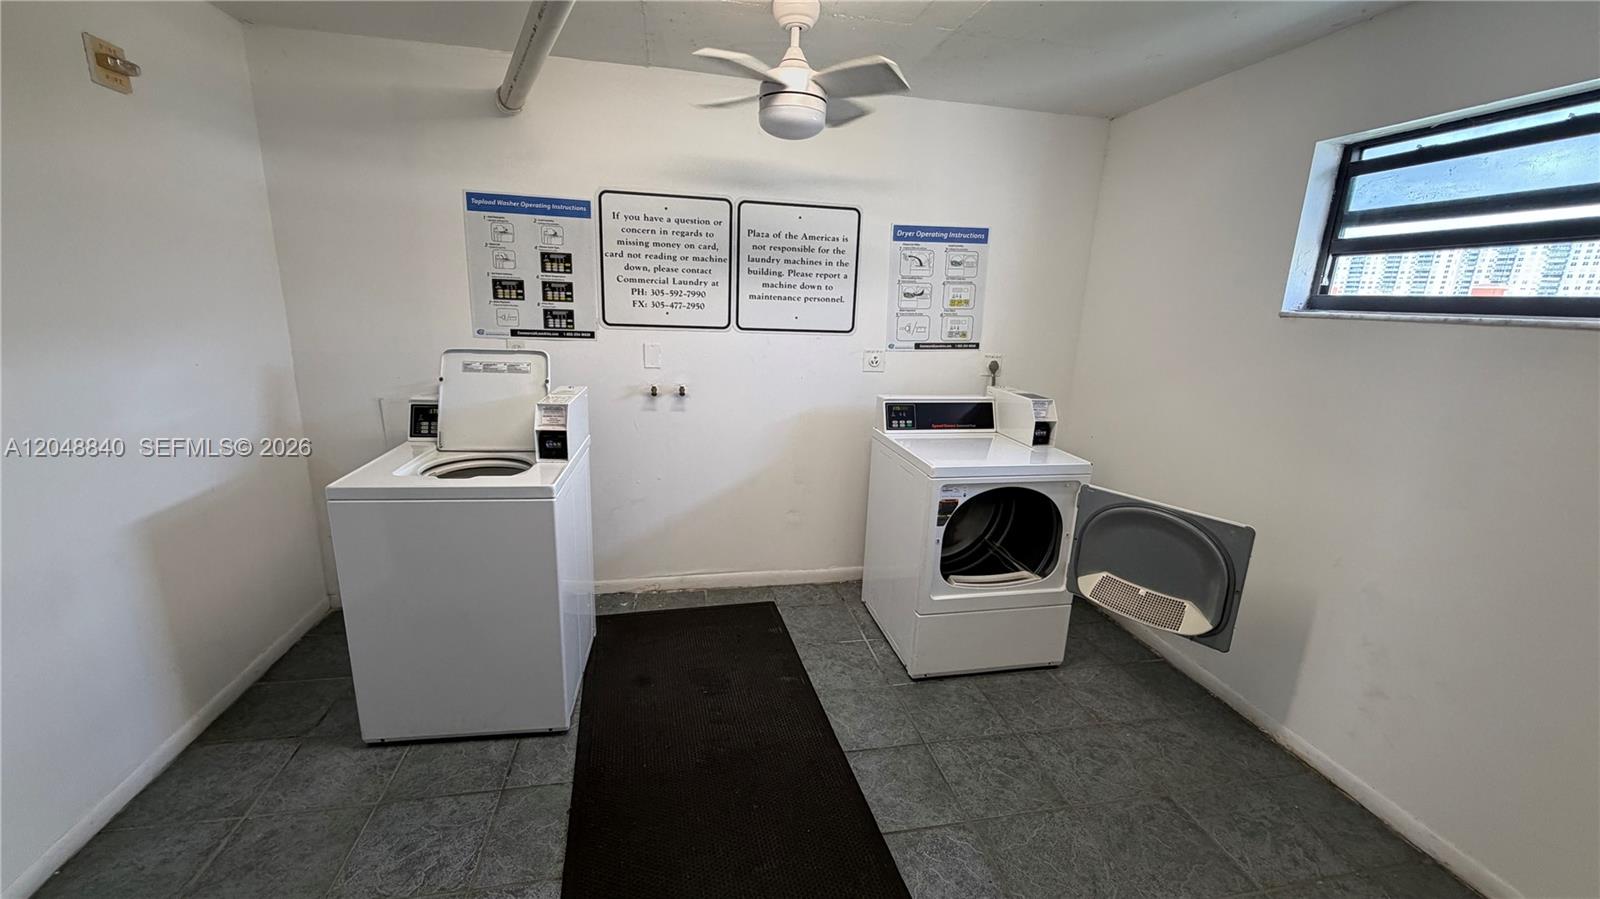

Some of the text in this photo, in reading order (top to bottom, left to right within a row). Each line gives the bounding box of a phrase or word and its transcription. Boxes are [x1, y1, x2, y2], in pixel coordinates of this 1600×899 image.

[470, 198, 496, 207] Topload
[520, 202, 551, 210] Operating
[612, 211, 620, 220] If
[643, 213, 664, 222] have
[674, 217, 710, 225] question
[659, 227, 668, 235] in
[671, 229, 703, 238] regards
[747, 228, 770, 238] Plaza
[772, 230, 782, 239] of
[784, 231, 798, 240] the
[800, 232, 839, 242] Americas
[896, 229, 915, 239] Dryer
[916, 230, 948, 239] Operating
[616, 238, 650, 248] missing
[697, 242, 719, 252] card,
[769, 244, 815, 254] responsible
[817, 246, 830, 254] for
[832, 246, 846, 255] the
[644, 252, 677, 262] reading
[692, 254, 728, 264] machine
[747, 254, 849, 267] laundry machines in the
[623, 262, 650, 272] down,
[653, 264, 679, 273] please
[747, 266, 784, 278] building.
[787, 268, 813, 278] Please
[616, 274, 669, 285] Commercial
[672, 277, 708, 286] Laundry
[761, 280, 797, 289] machine
[799, 281, 822, 290] down
[630, 287, 706, 298] PH: 305-592-7990
[748, 292, 845, 303] maintenance personnel.
[632, 299, 705, 310] FX: 305-477-2950
